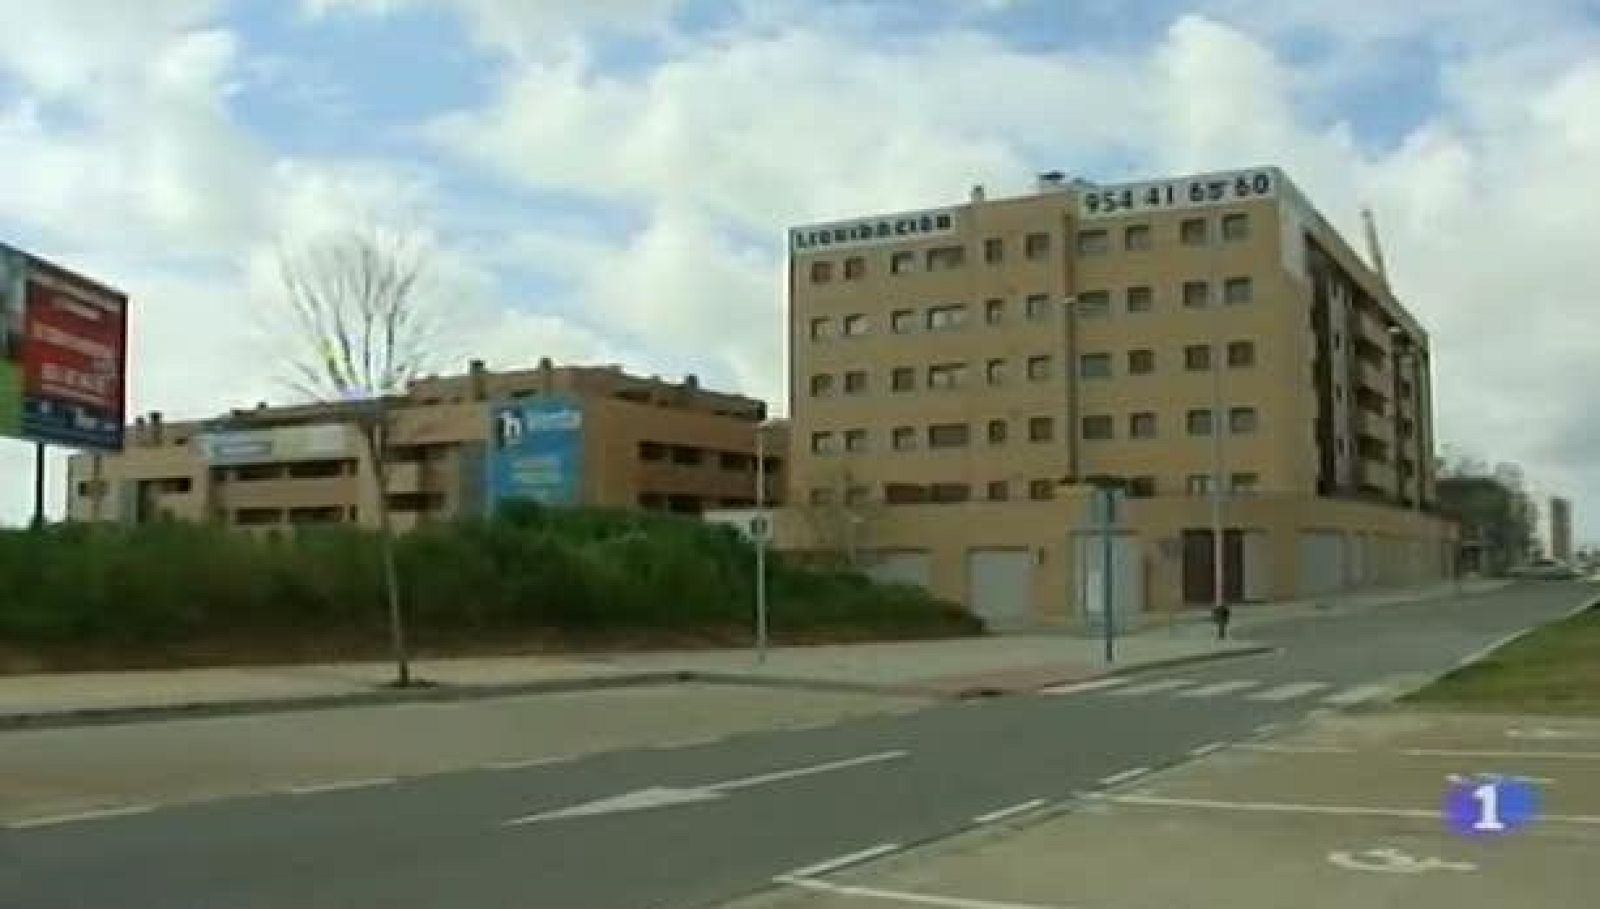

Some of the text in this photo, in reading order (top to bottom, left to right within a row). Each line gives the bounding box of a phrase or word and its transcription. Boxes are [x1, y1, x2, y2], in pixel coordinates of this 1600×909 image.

[1086, 190, 1133, 214] 954
[1145, 185, 1174, 206] 41
[1235, 174, 1270, 197] 60
